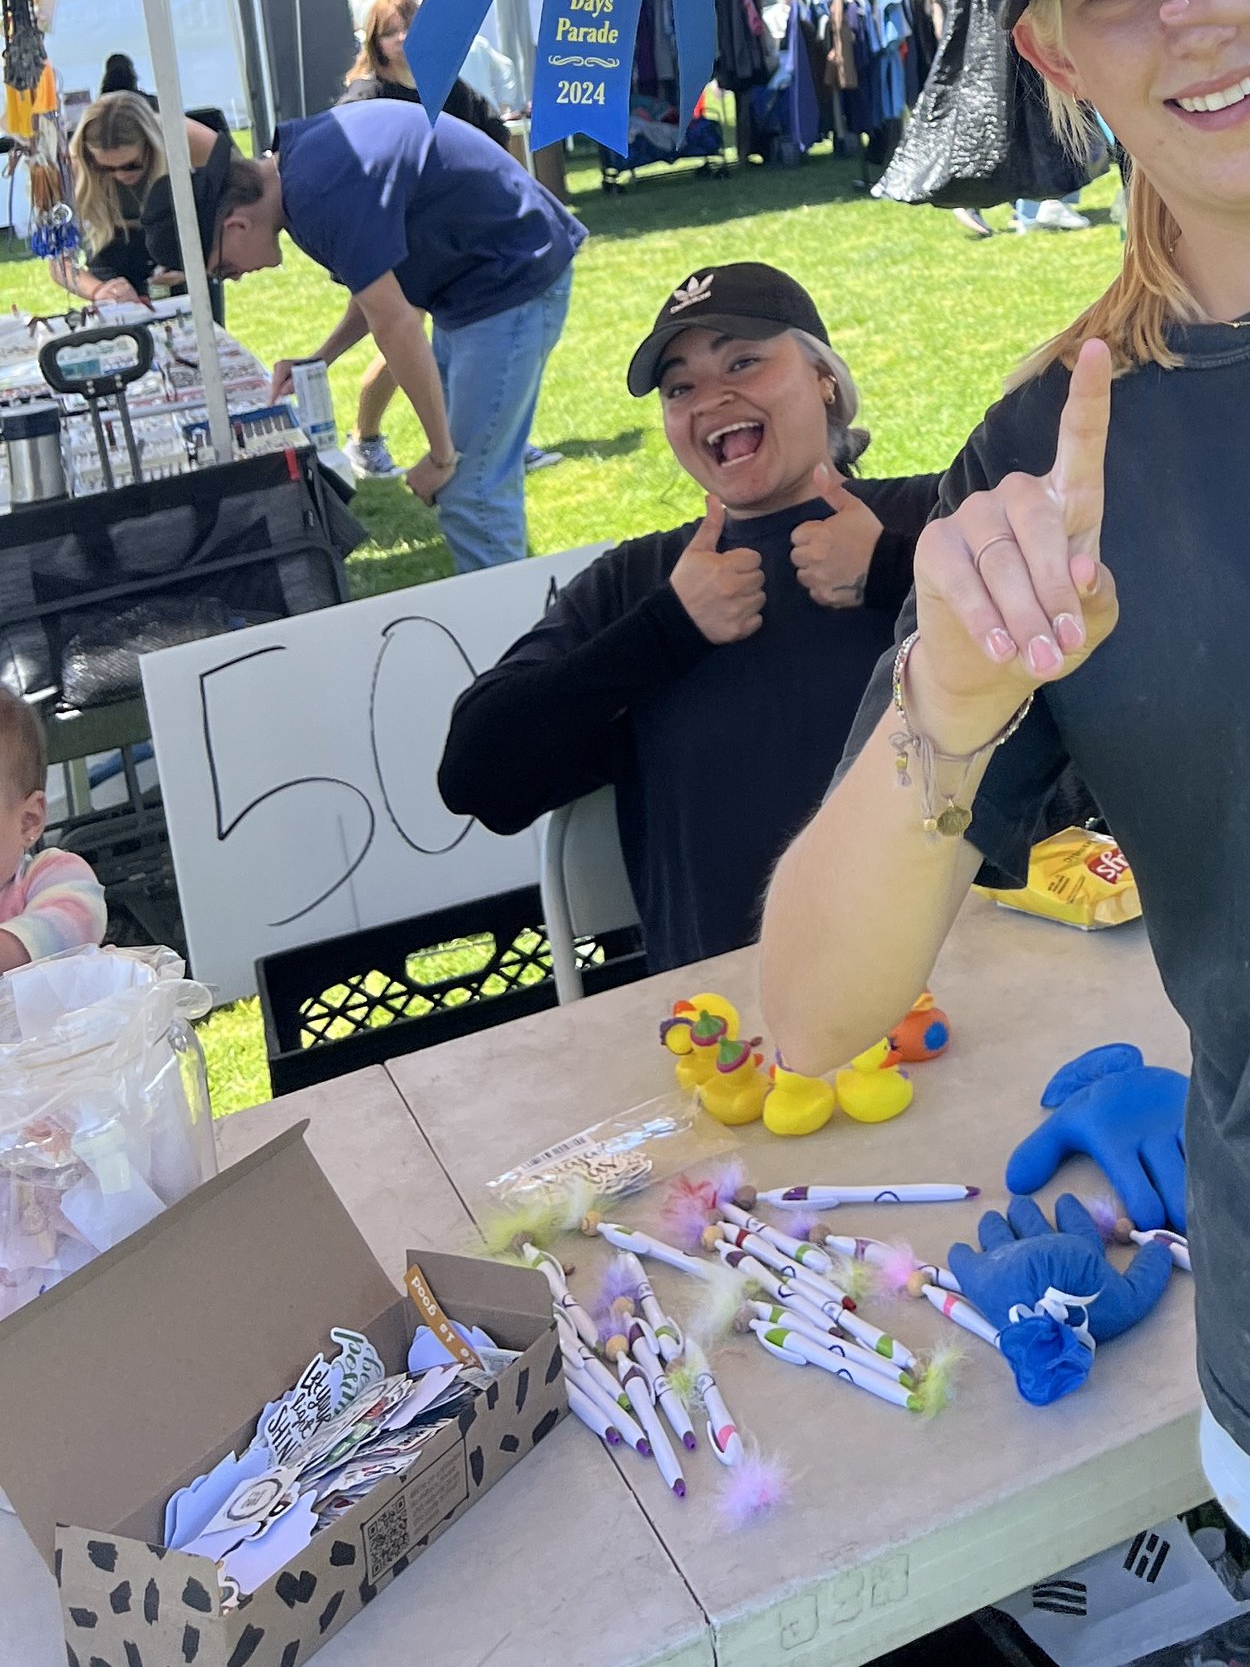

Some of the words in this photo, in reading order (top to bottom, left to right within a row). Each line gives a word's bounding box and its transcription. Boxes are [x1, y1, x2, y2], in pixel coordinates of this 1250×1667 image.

[555, 17, 619, 44] Parade
[556, 80, 606, 105] 2024
[410, 1276, 438, 1317] good
